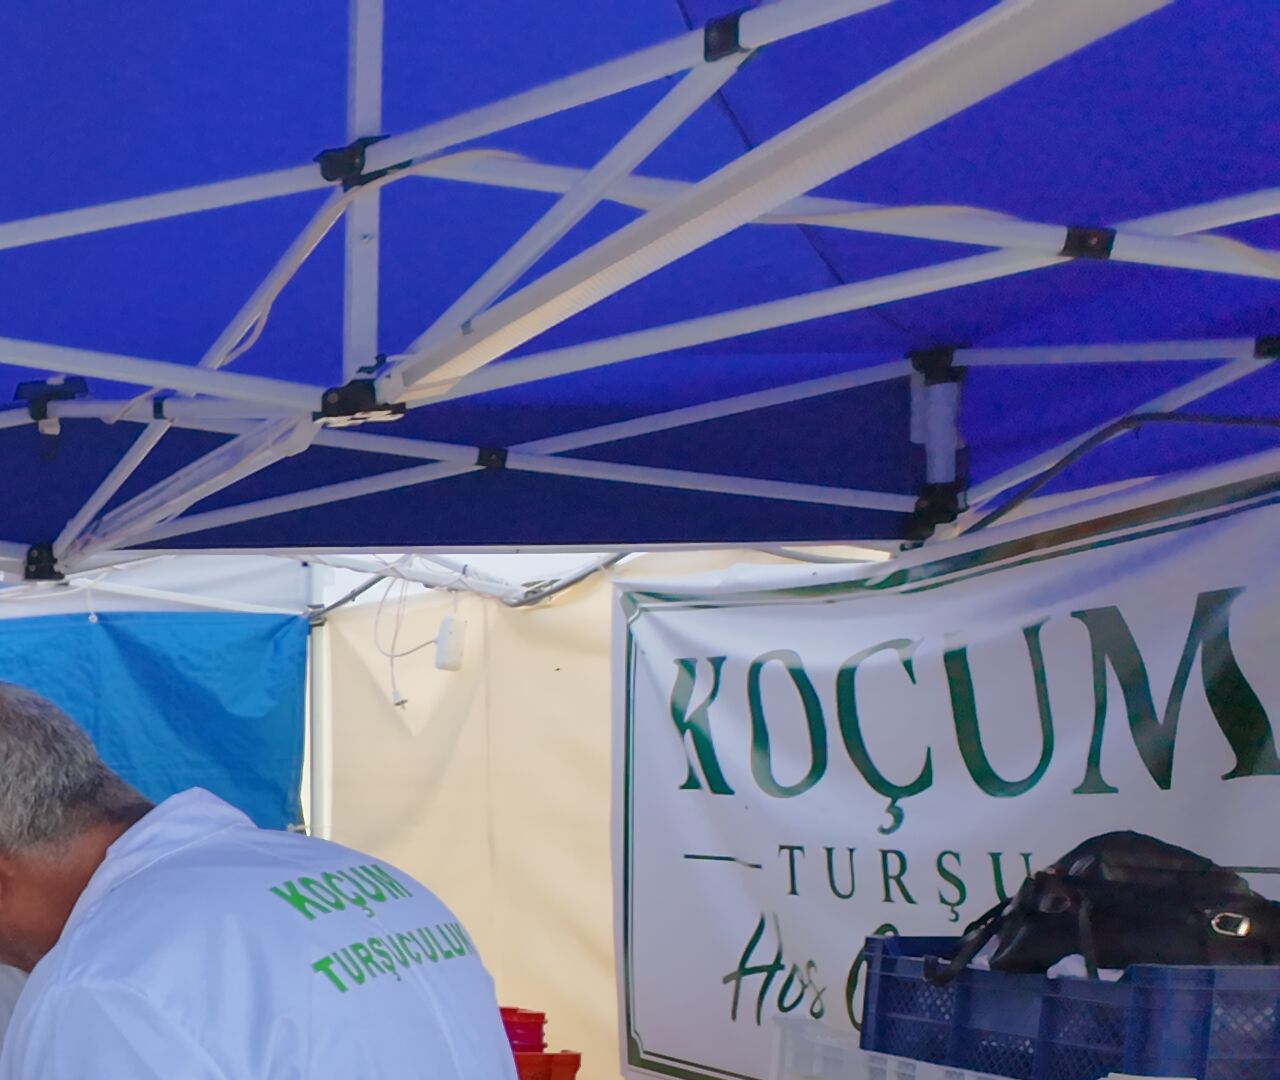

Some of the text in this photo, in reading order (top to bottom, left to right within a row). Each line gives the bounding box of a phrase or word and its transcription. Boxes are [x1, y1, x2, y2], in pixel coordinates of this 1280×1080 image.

[669, 585, 1280, 834] KOÇUM
[270, 864, 414, 920] KOÇUM
[312, 922, 474, 994] TURŞUCULUK
